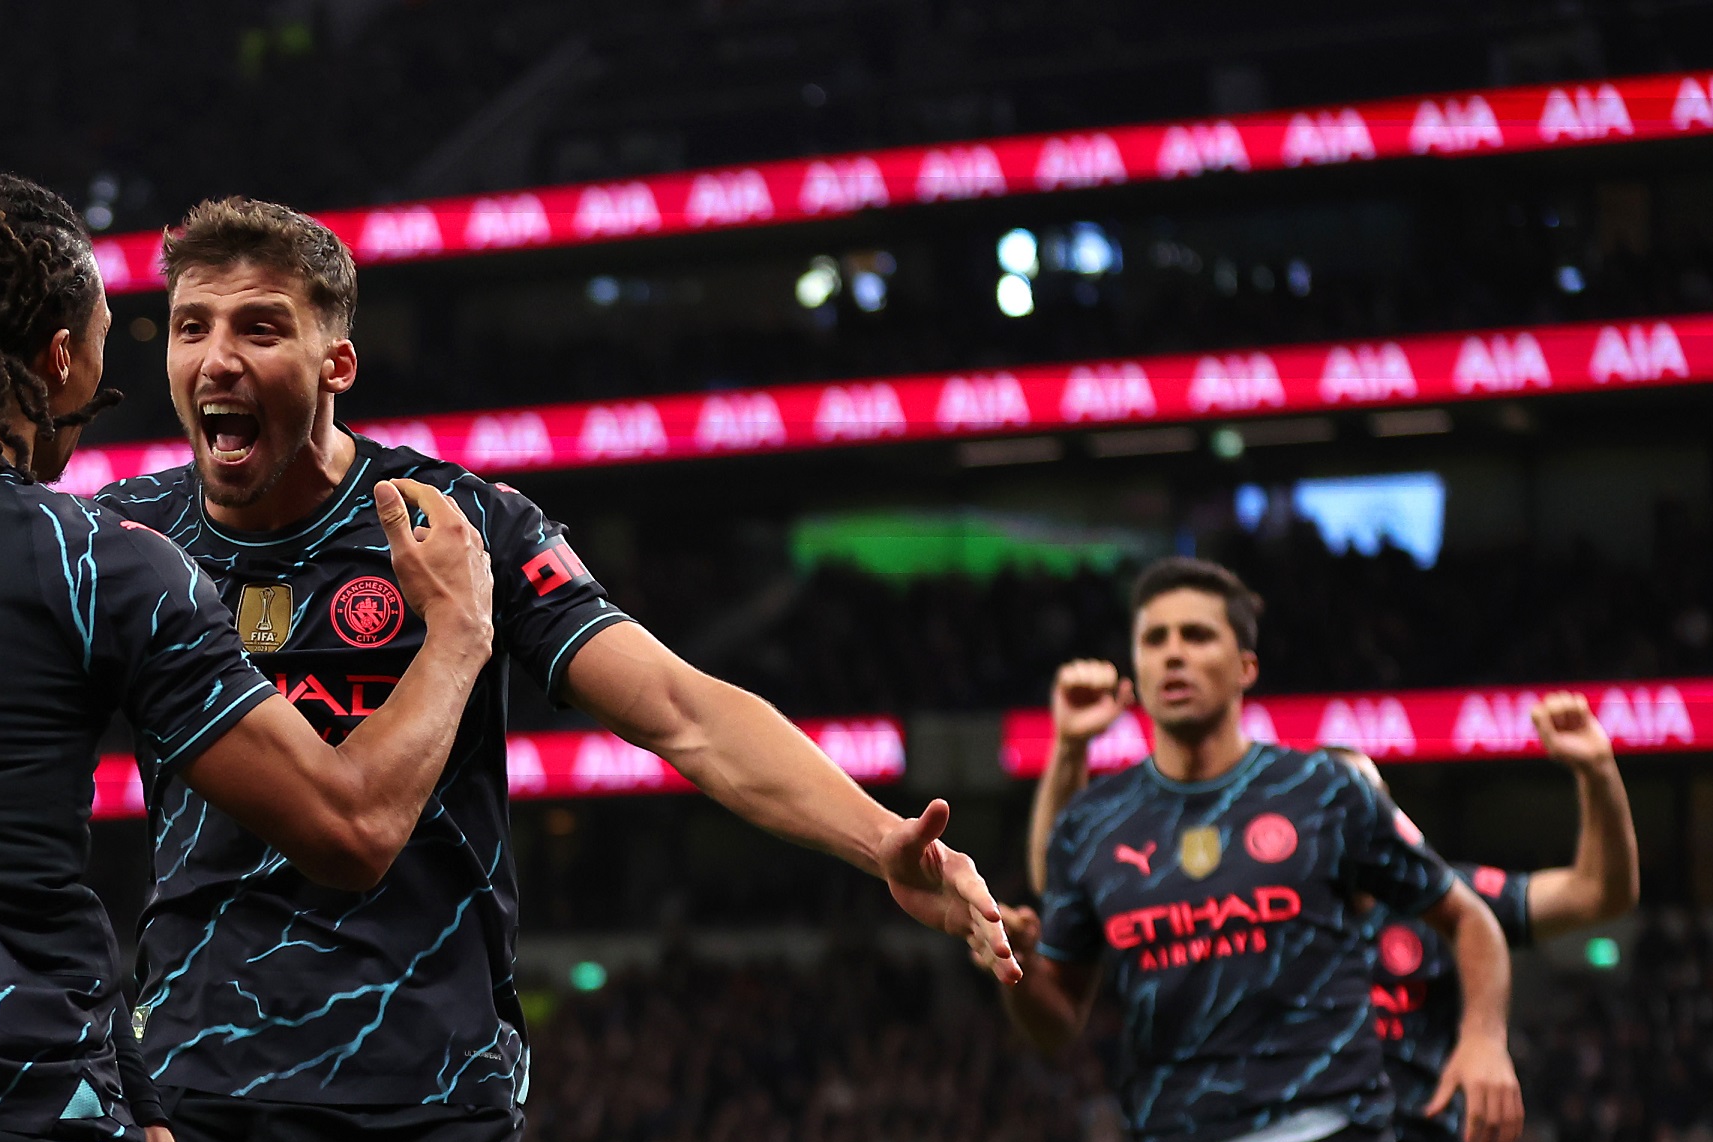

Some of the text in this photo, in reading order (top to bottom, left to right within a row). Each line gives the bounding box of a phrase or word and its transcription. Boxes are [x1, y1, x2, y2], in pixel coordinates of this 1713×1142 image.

[1409, 98, 1502, 152] AIA
[1539, 85, 1634, 140] AIA
[1319, 343, 1417, 400] AIA
[1453, 334, 1551, 392] AIA
[1590, 322, 1688, 381] AIA
[340, 582, 396, 603] MANCHESTER
[251, 631, 275, 642] FIFA
[356, 634, 378, 642] CITY
[1104, 886, 1301, 949] ETIHAD
[1139, 926, 1267, 972] AIRWAYS
